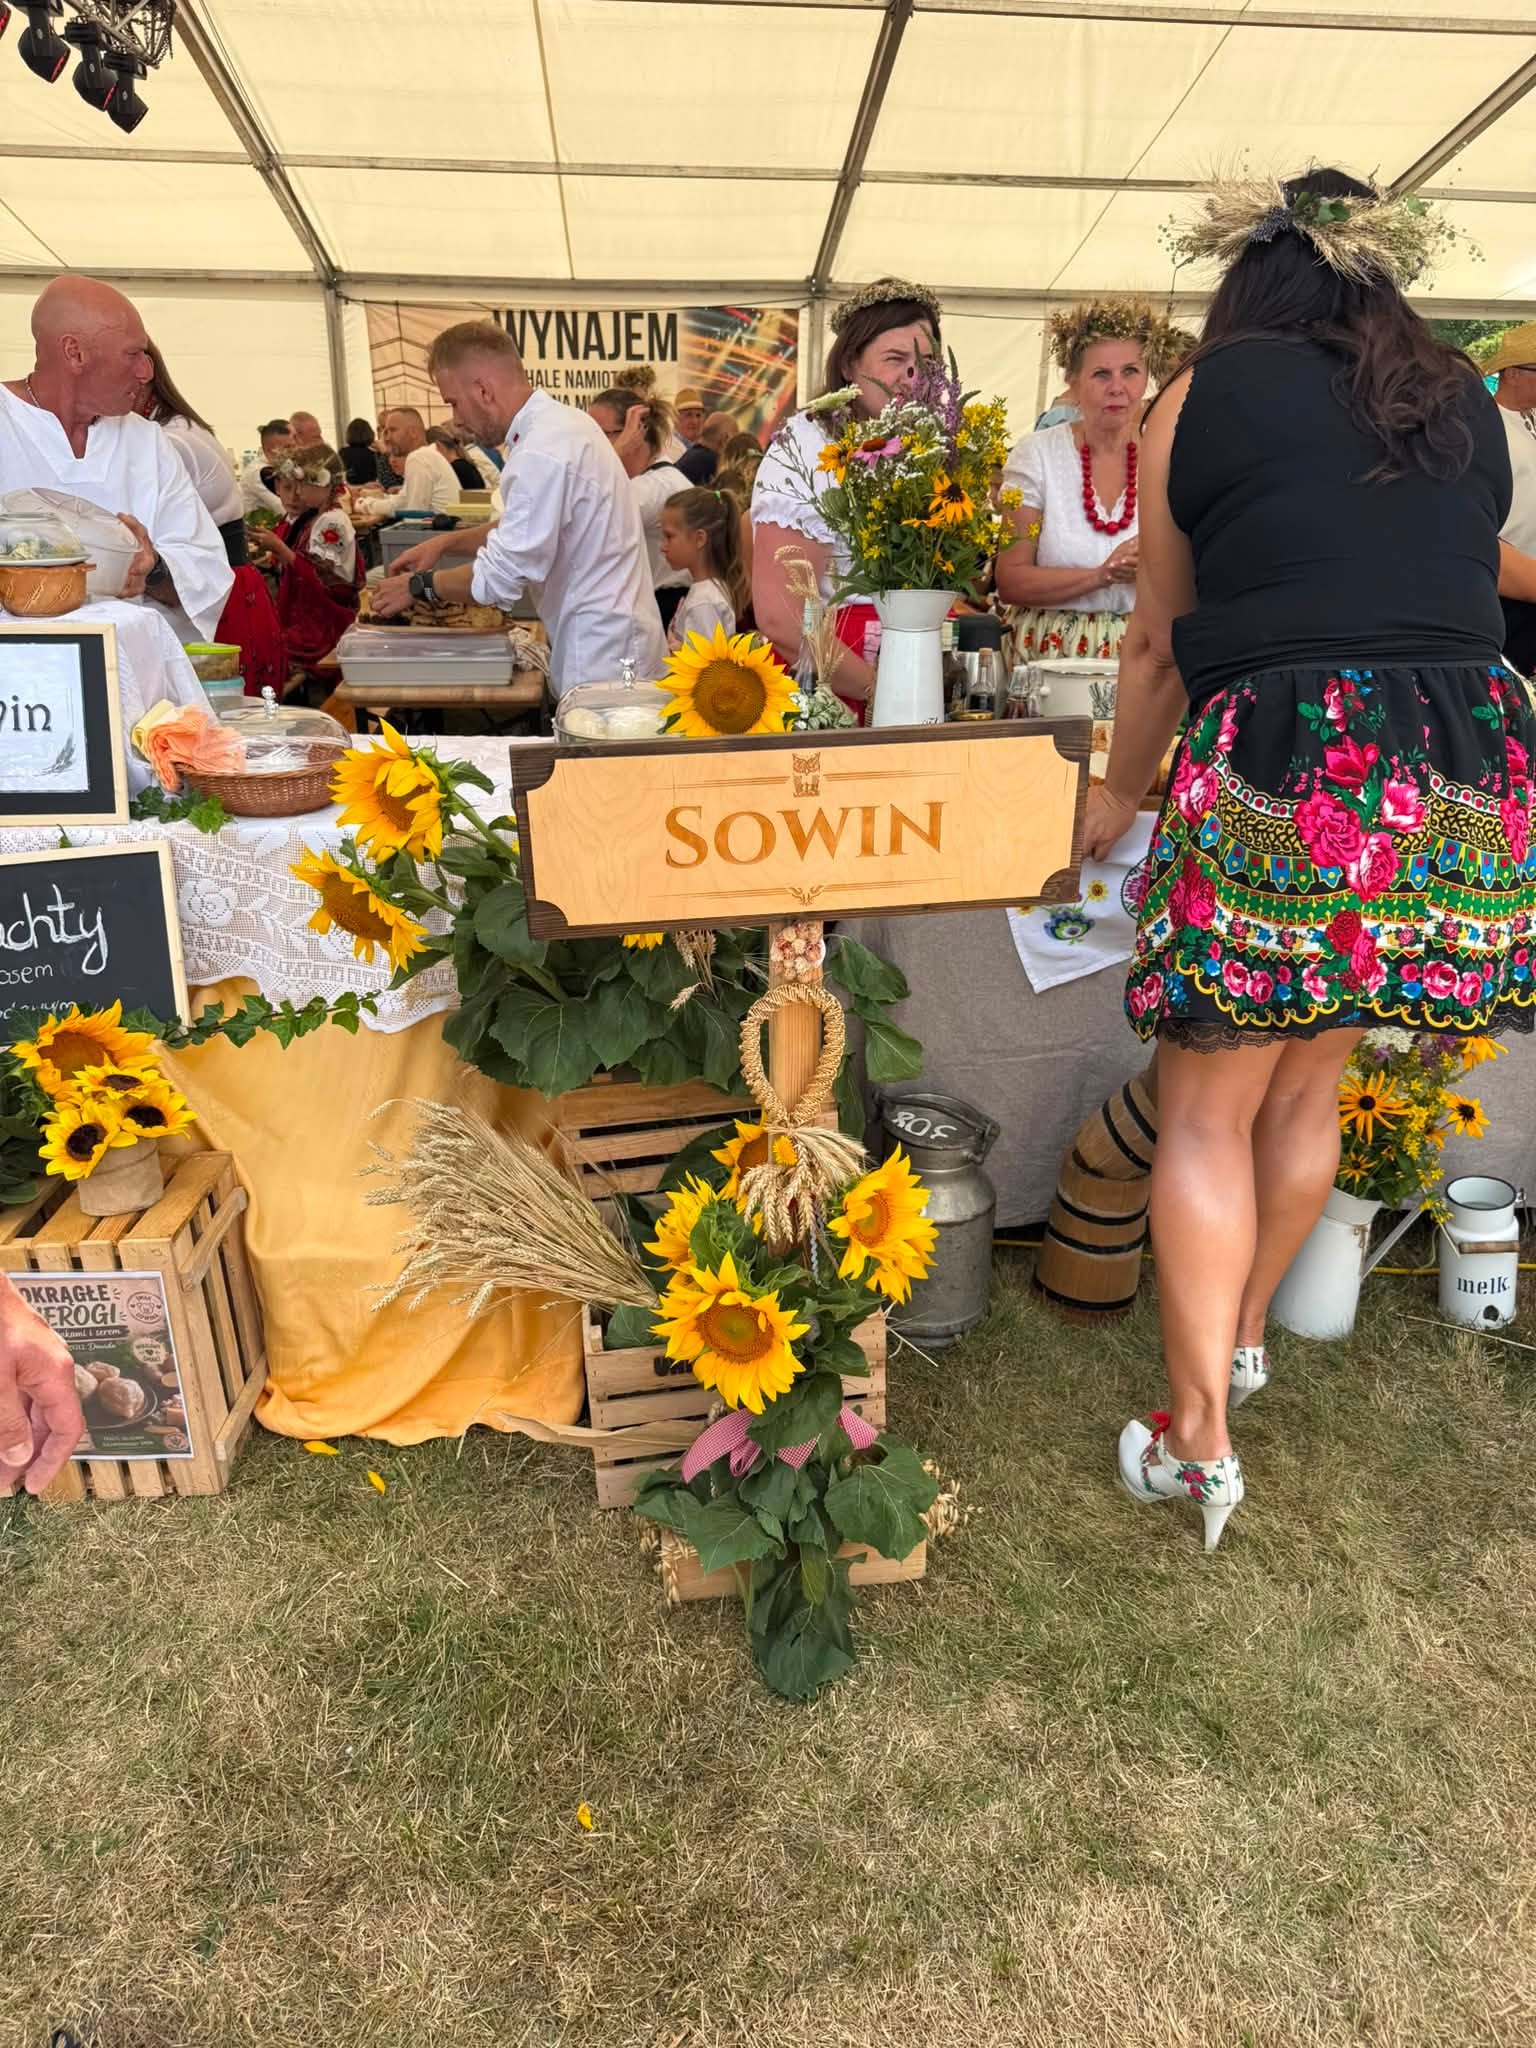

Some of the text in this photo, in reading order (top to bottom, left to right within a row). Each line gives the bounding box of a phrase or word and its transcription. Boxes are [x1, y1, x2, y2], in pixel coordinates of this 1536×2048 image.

[493, 310, 677, 361] WYNAJEM
[525, 369, 560, 388] HALE
[665, 801, 948, 869] SOWIN
